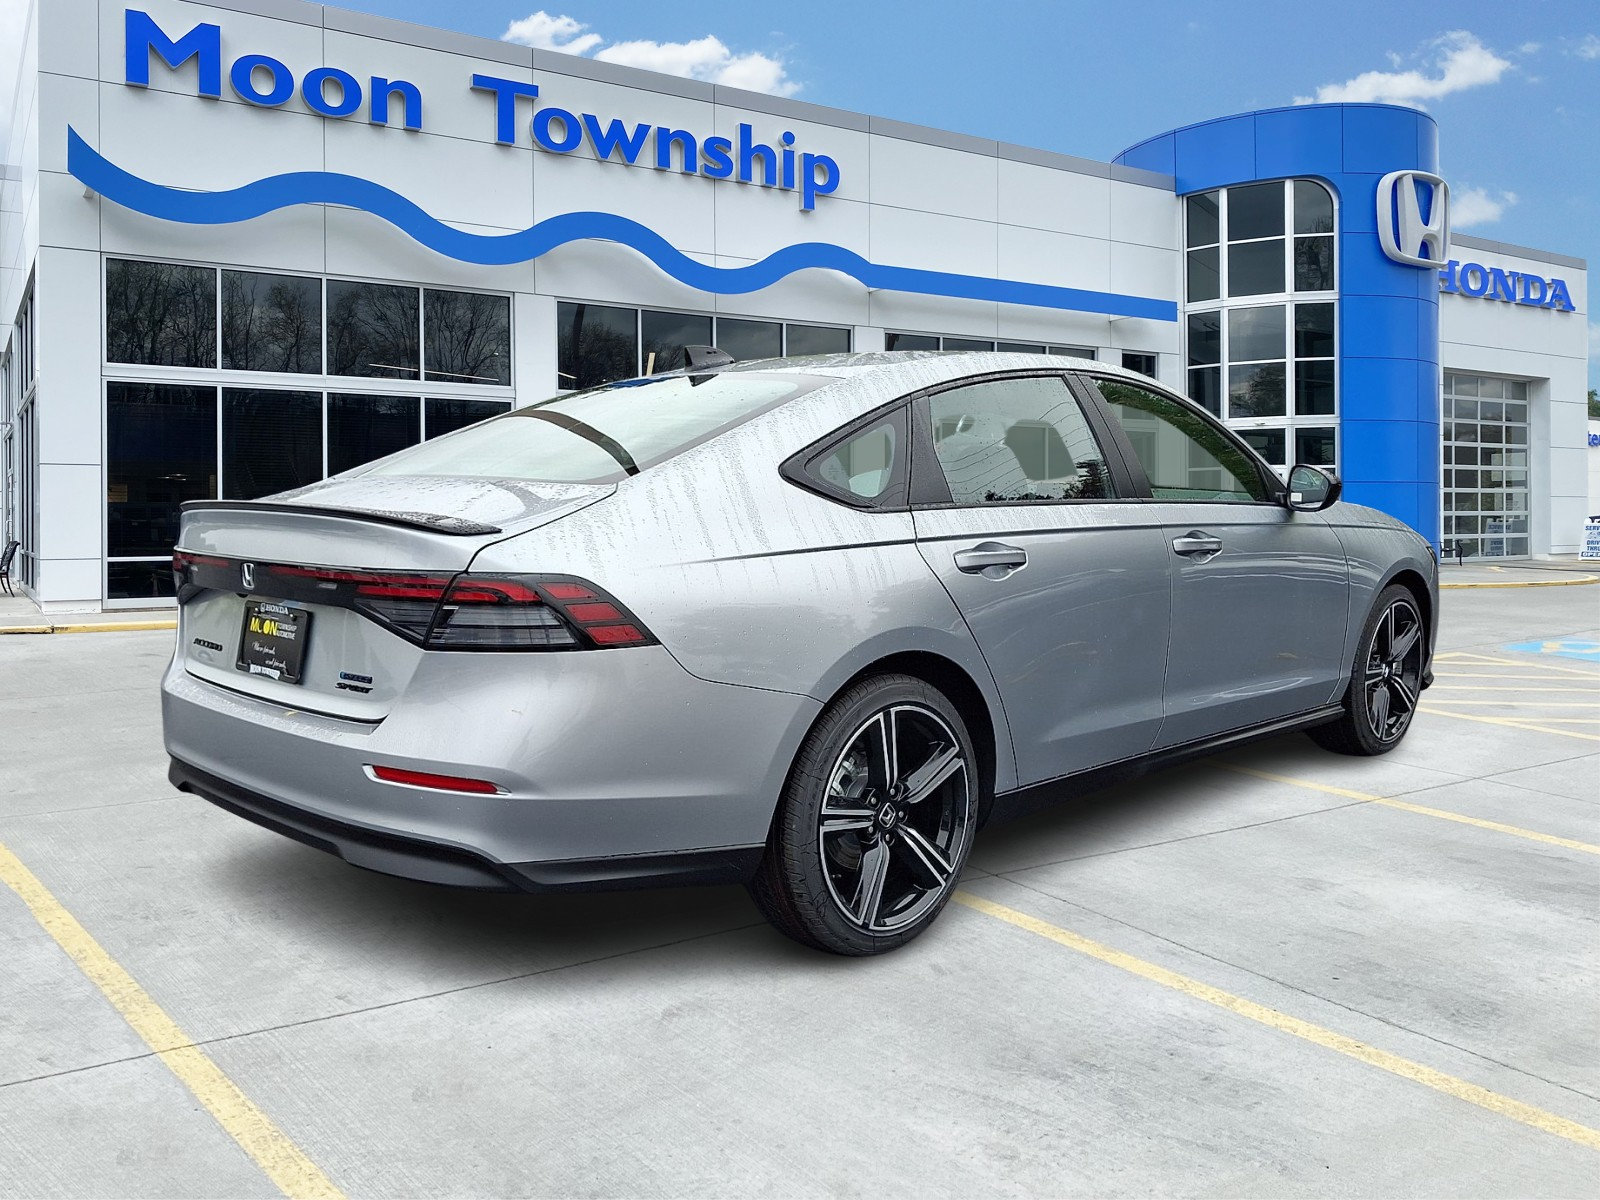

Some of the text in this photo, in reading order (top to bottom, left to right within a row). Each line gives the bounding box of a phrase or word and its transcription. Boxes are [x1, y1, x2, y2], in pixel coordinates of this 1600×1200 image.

[125, 9, 841, 212] Moon Township
[1438, 259, 1576, 312] HONDA
[1588, 430, 1600, 447] te
[265, 604, 289, 615] HONDA
